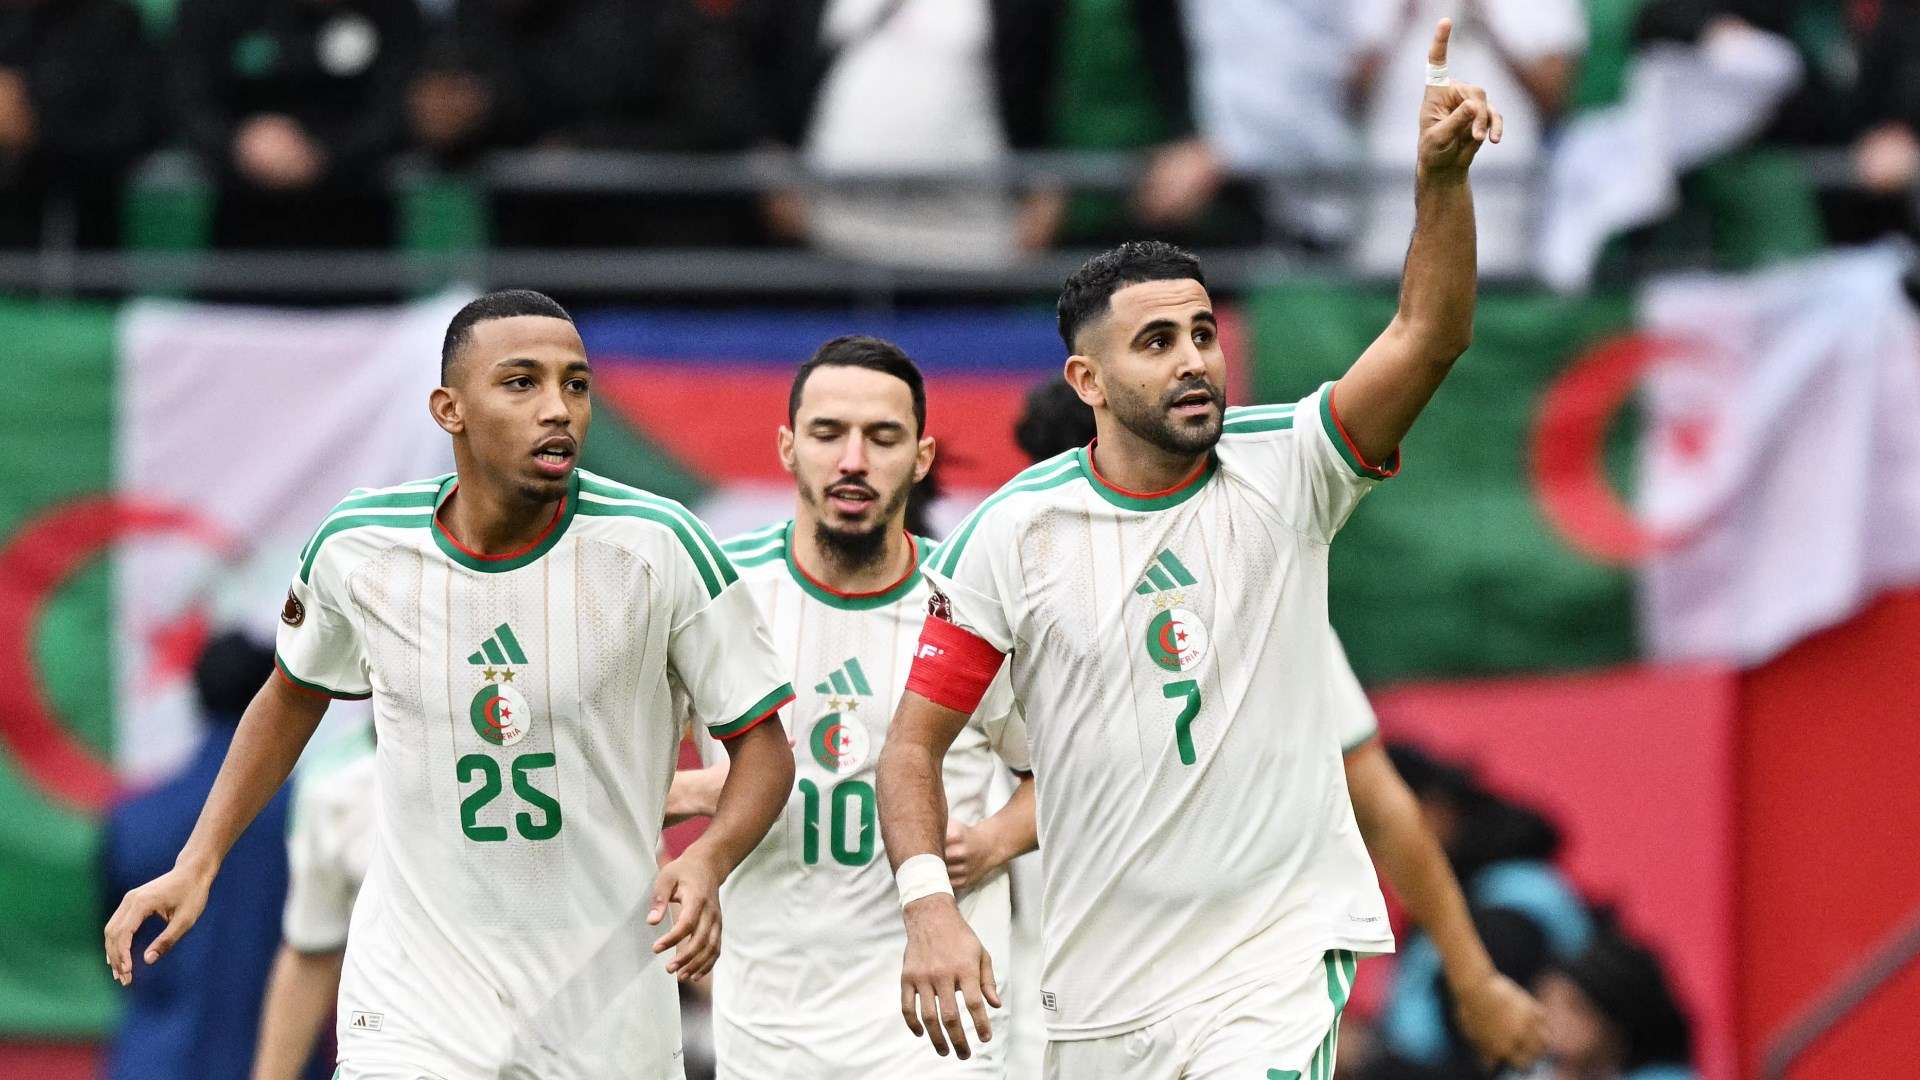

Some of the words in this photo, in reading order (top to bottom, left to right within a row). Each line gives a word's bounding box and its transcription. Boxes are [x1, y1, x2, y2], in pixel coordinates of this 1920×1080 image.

[482, 728, 521, 740] ERIA
[1163, 679, 1201, 765] 7
[456, 752, 562, 842] 25
[799, 778, 875, 867] 10
